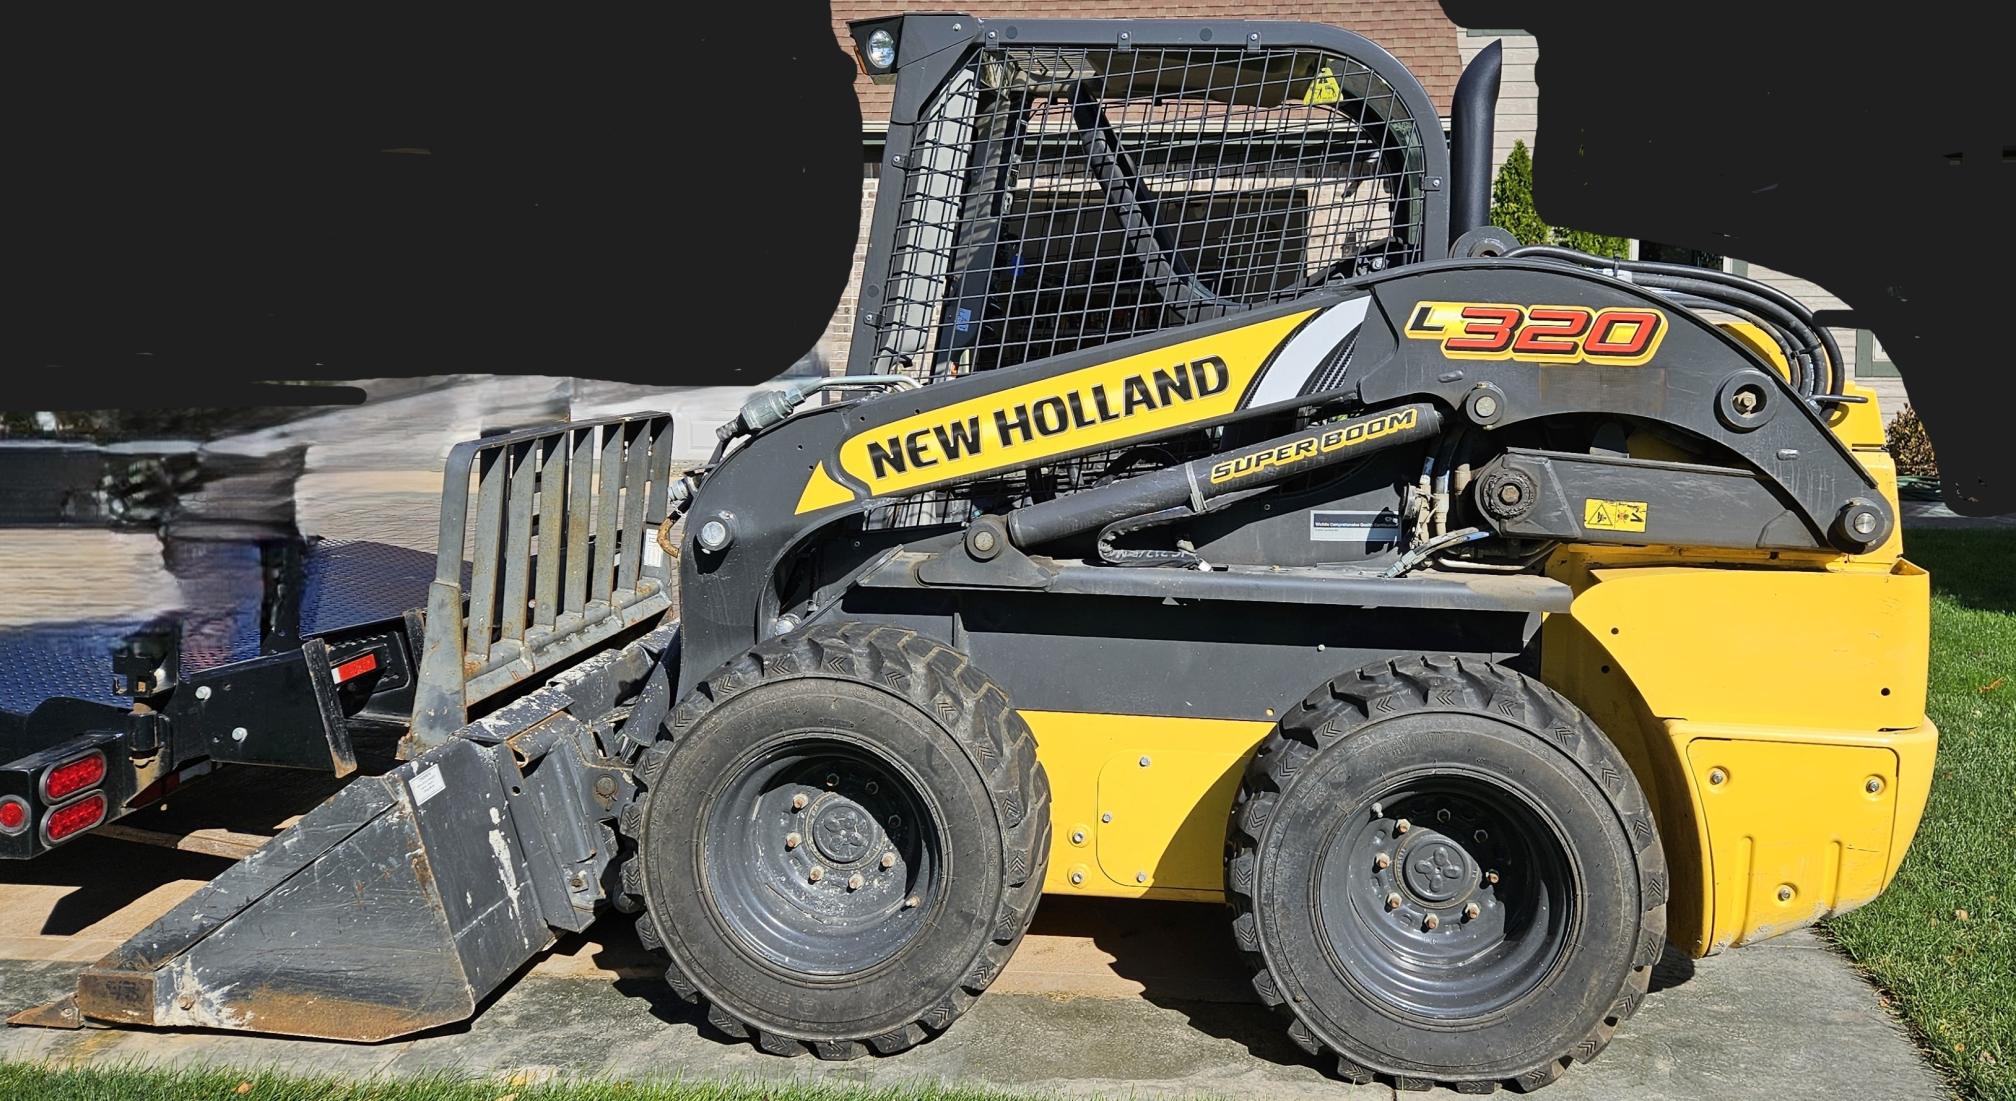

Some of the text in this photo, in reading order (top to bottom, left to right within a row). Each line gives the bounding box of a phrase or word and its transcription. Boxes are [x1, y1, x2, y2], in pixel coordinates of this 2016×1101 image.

[1406, 303, 1664, 362] L320
[866, 354, 1231, 480] NEW HOLLAND
[1212, 409, 1418, 482] SUPER BOOM
